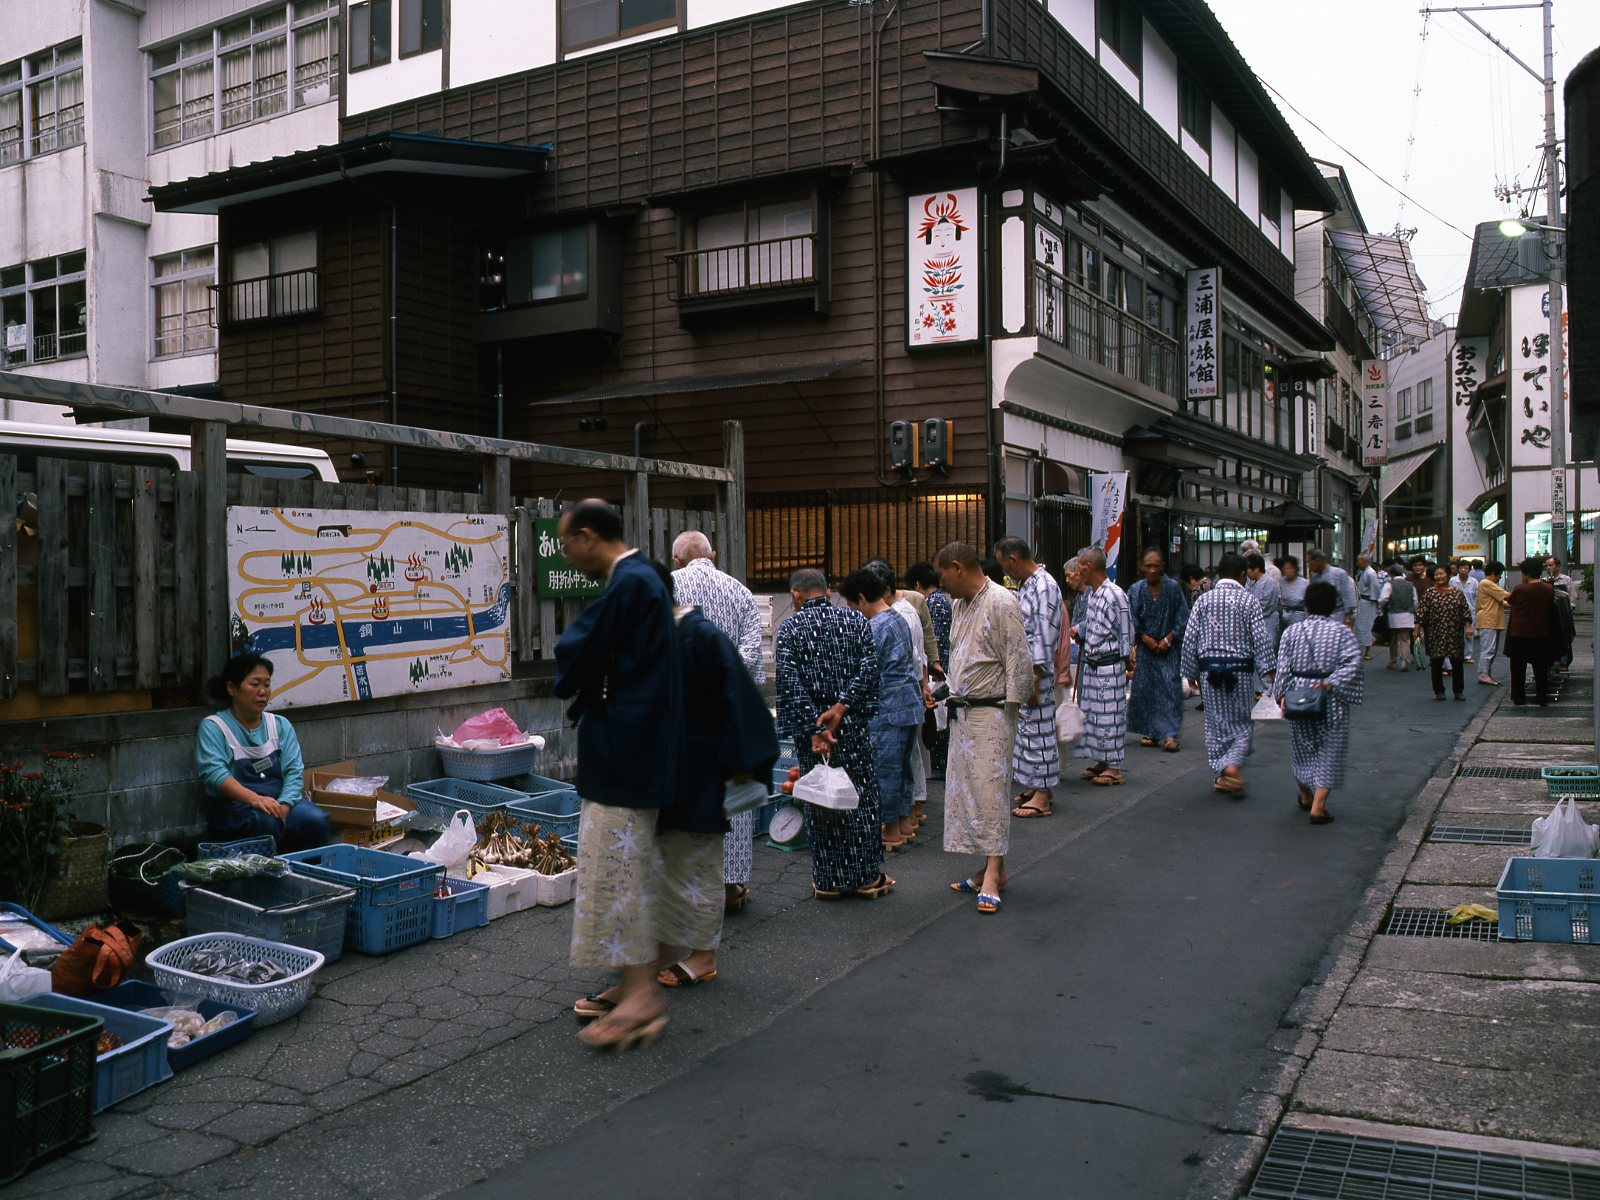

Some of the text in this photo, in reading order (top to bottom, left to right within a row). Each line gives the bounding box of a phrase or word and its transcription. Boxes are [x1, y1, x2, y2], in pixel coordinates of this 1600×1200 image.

[1195, 274, 1215, 383] 三浦屋旅館
[1366, 395, 1384, 449] 三春屋
[1111, 488, 1120, 522] ようこそ
[236, 525, 243, 534] N
